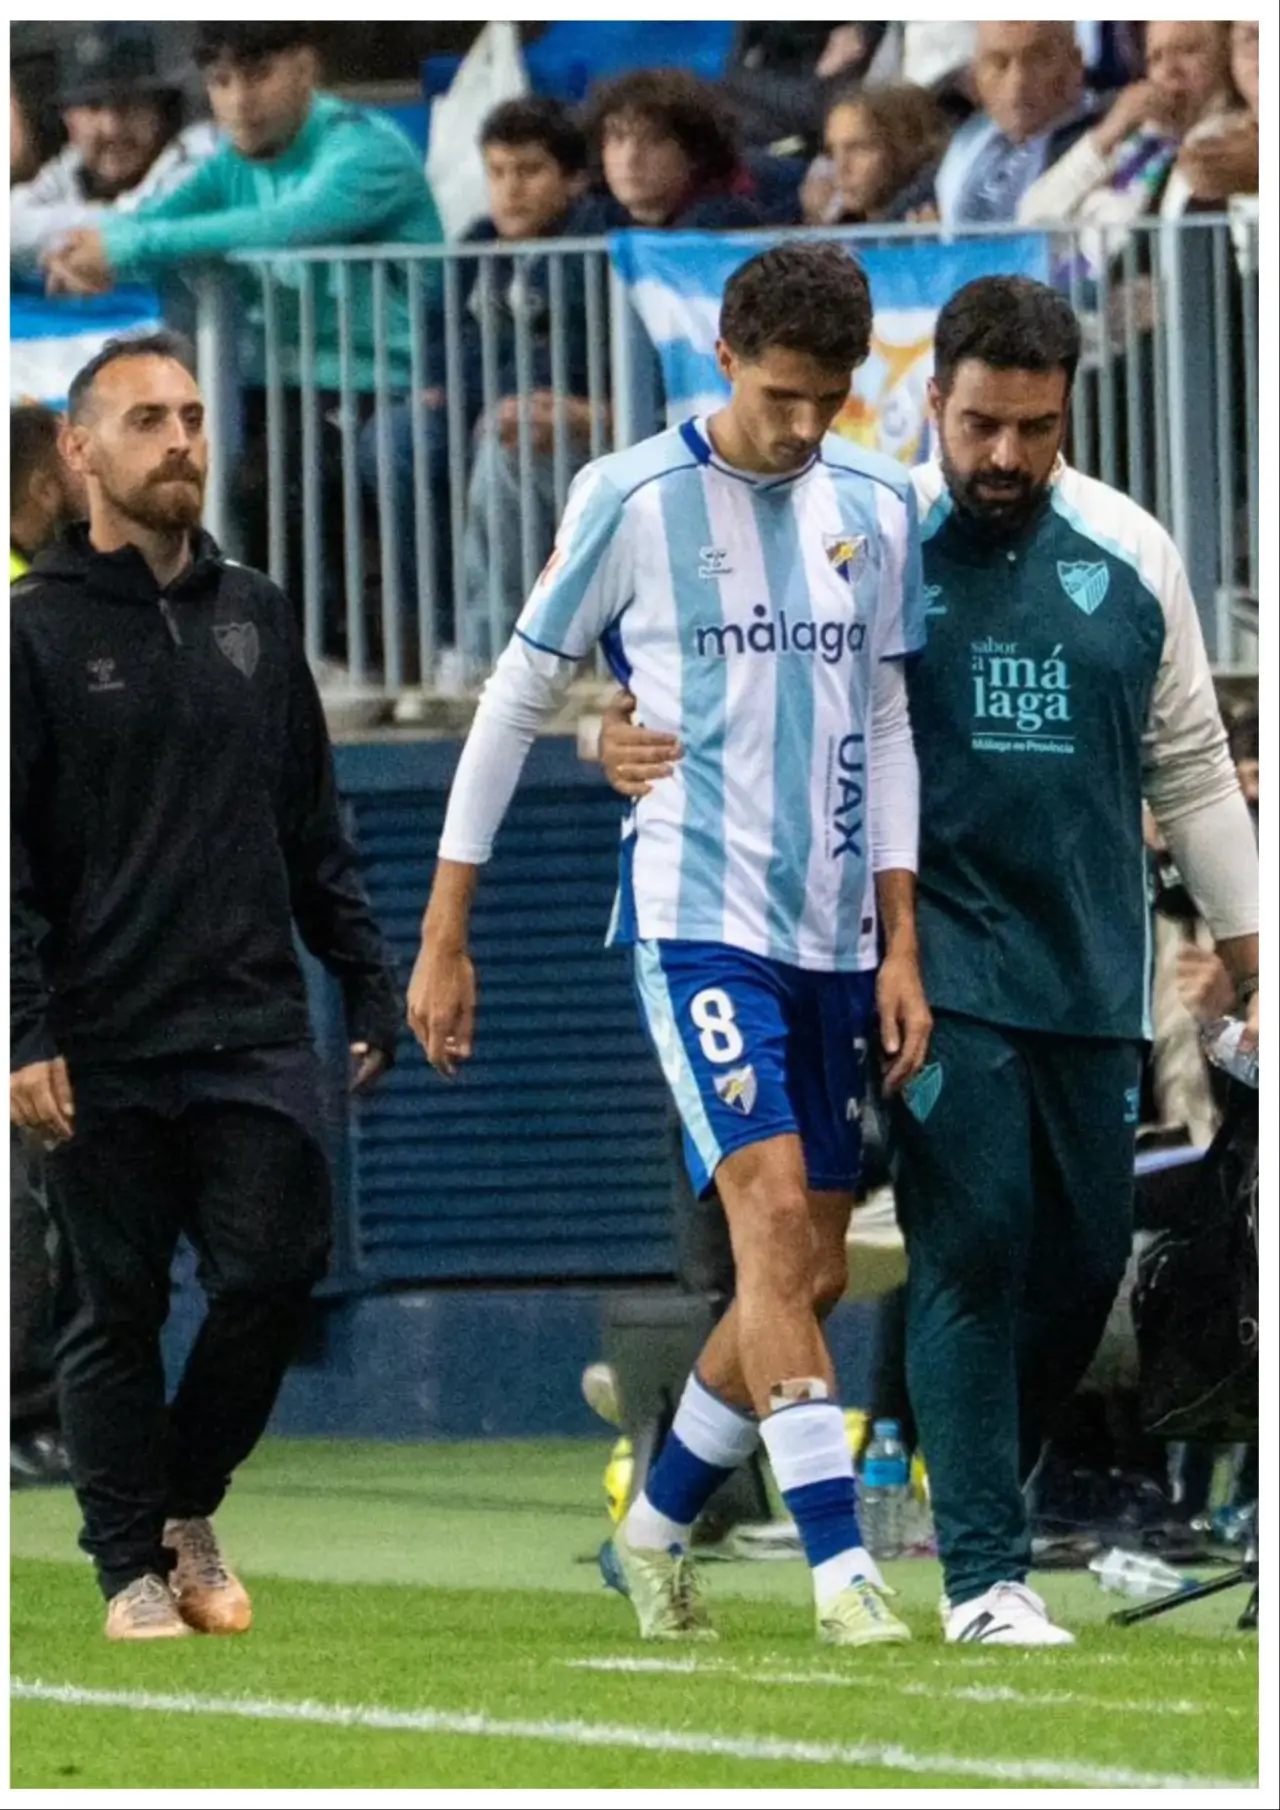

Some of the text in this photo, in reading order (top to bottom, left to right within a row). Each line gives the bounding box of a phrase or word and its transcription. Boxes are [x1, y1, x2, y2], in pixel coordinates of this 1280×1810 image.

[970, 636, 1018, 654] sabor
[989, 643, 1071, 690] má
[972, 676, 1072, 732] laga
[831, 733, 865, 859] UAX
[690, 987, 743, 1063] 8
